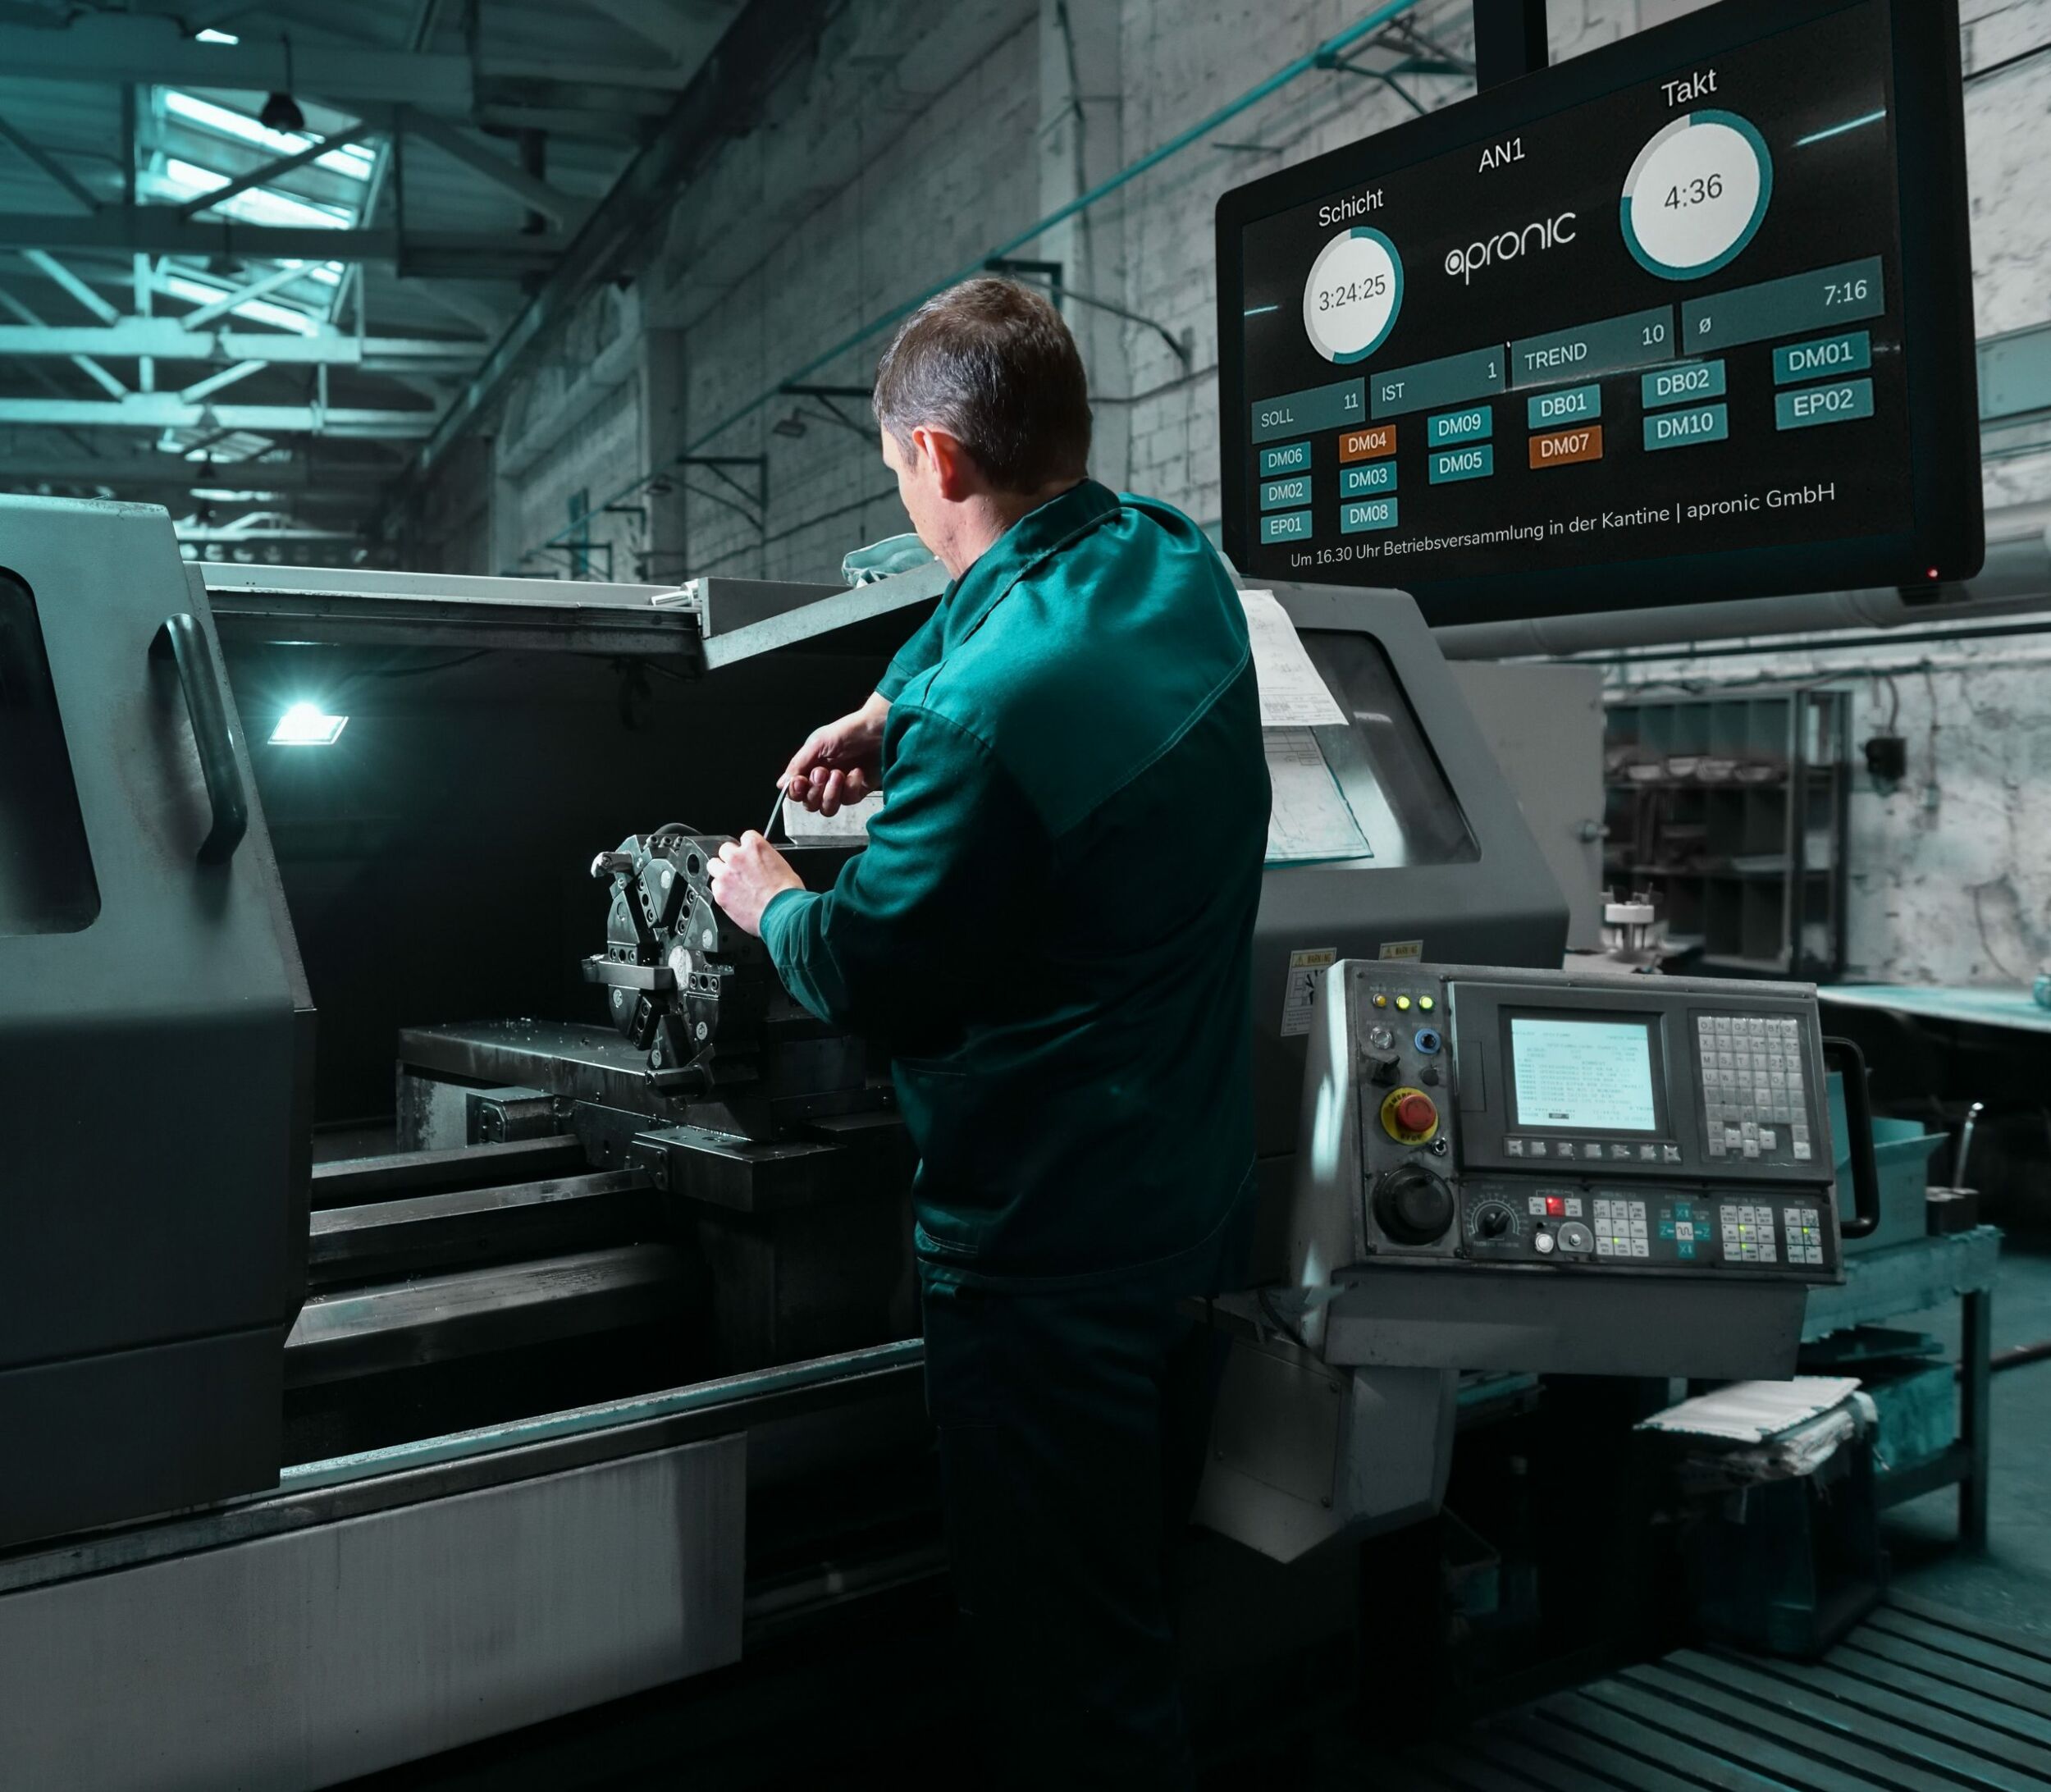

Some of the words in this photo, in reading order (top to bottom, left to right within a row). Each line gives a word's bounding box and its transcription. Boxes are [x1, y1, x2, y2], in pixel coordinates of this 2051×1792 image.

[1660, 69, 1717, 107] Takt
[1478, 137, 1525, 173] AN1
[1664, 173, 1723, 210] 4:36
[1318, 188, 1384, 228] Schicht
[1444, 212, 1576, 286] apronic
[1318, 274, 1387, 313] 3:24:25
[1824, 279, 1867, 306] 7:16
[1524, 342, 1587, 370] TREND
[1642, 324, 1665, 345] 10
[1788, 341, 1854, 371] DM01
[1382, 382, 1405, 402] IST
[1488, 362, 1497, 379] 1
[1656, 368, 1710, 396] DB02
[1261, 408, 1294, 427] SOLL
[1344, 392, 1359, 410] 11
[1541, 393, 1587, 418] DB01
[1793, 388, 1854, 417] EP02
[1438, 413, 1482, 437] DM09
[1657, 412, 1714, 439] DM10
[1348, 431, 1387, 453] DM04
[1541, 432, 1589, 458] DM07
[1268, 447, 1303, 469] DM06
[1439, 451, 1482, 474] DM05
[1268, 482, 1304, 501] DM02
[1349, 467, 1388, 488] DM03
[1270, 516, 1302, 535] EP01
[1291, 553, 1312, 568] Um
[1316, 546, 1353, 565] 16.30
[1356, 543, 1381, 560] Uhr
[1383, 524, 1544, 556] Betriebsversammlung
[1549, 519, 1564, 535] in
[1569, 516, 1597, 533] der
[1602, 507, 1670, 529] Kantine
[1687, 493, 1760, 521] apronic
[1766, 482, 1834, 508] GmbH
[1350, 504, 1389, 524] DM08
